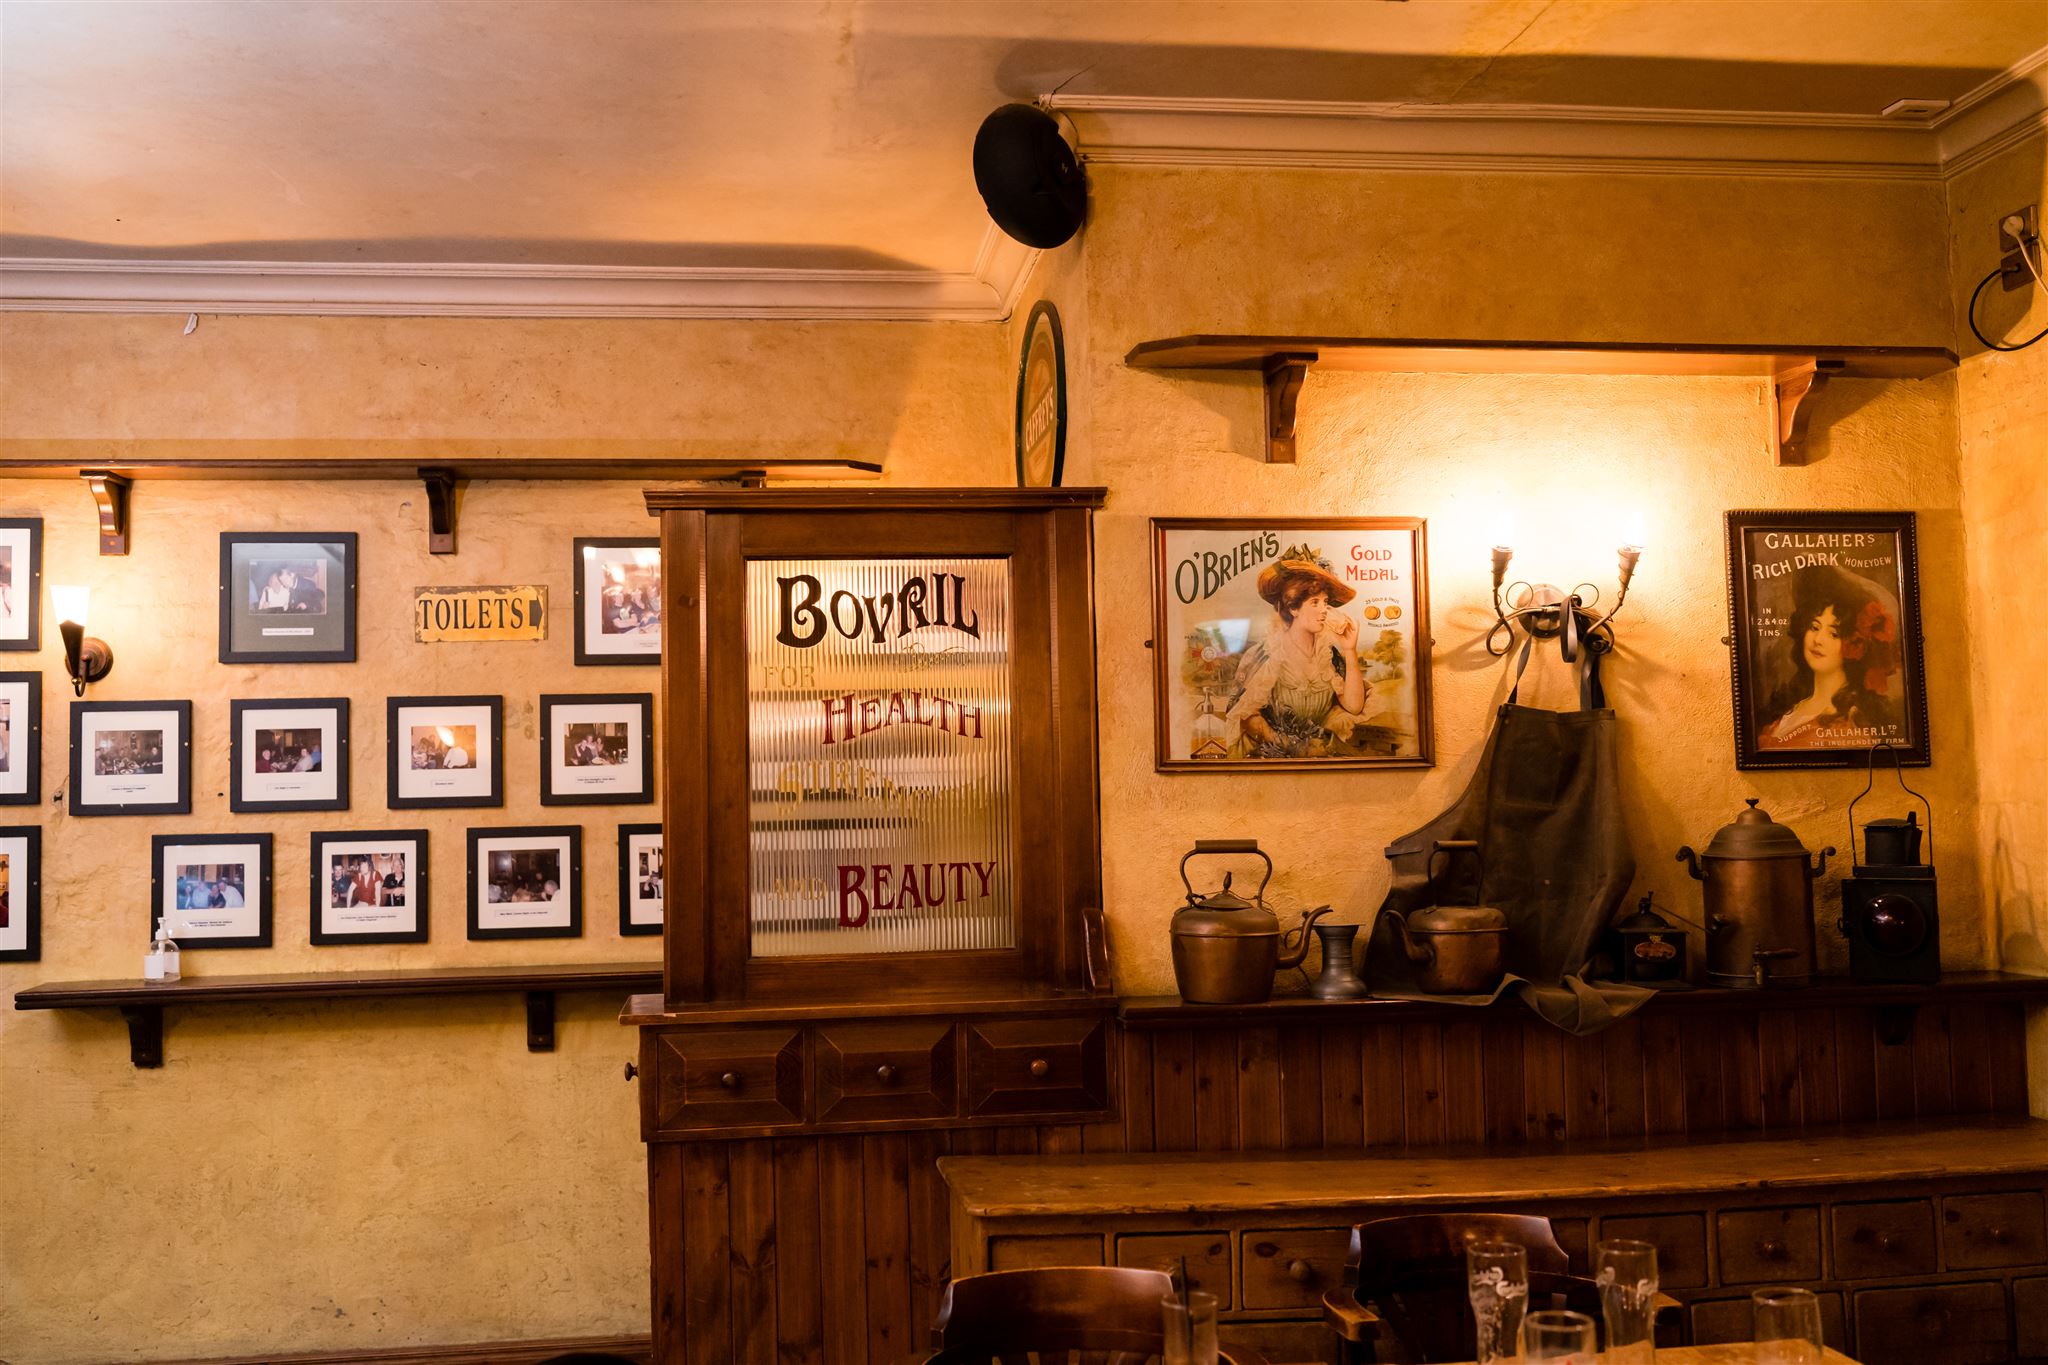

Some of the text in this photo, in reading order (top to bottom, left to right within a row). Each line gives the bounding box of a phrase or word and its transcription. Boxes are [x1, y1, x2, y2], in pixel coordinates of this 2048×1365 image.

[1351, 545, 1392, 561] GOLD
[1752, 560, 1792, 580] RICH
[1794, 552, 1839, 570] DARK
[1175, 531, 1280, 604] O'BRIEN'S
[1346, 565, 1399, 581] MEDAL
[419, 597, 524, 630] TOILETS
[776, 573, 980, 648] BOVRIL
[764, 666, 815, 688] FOR
[822, 691, 983, 745] HEALTH
[1777, 724, 1811, 743] SUPPORT
[1828, 738, 1881, 747] INDEPENDENT
[837, 862, 997, 928] BEAUTY
